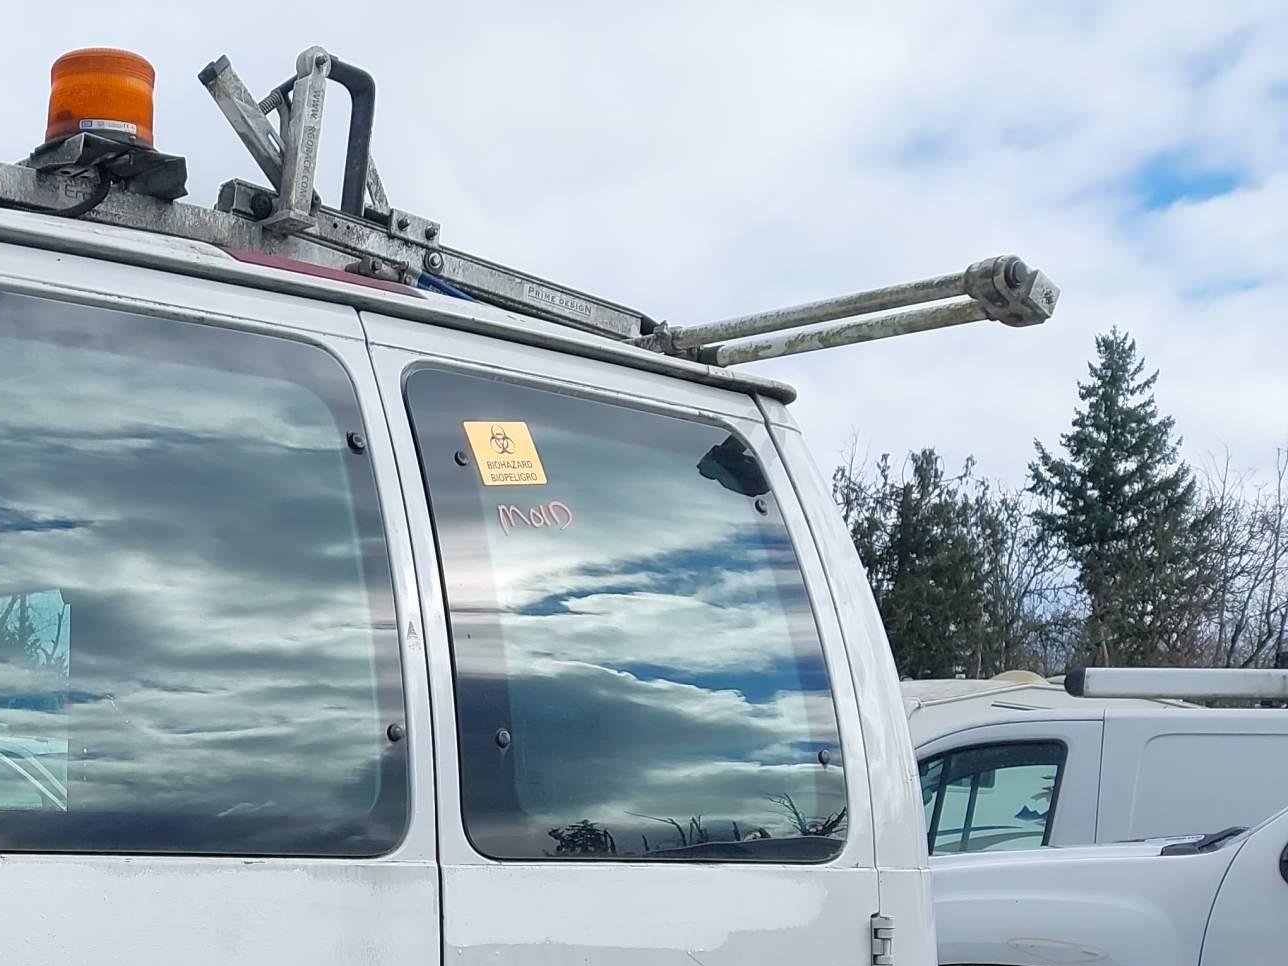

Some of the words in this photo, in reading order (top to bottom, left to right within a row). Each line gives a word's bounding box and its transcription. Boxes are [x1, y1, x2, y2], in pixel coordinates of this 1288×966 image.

[528, 286, 556, 303] PRIME
[558, 297, 592, 314] DESIGN
[486, 460, 533, 470] BIOHAZARD
[490, 472, 538, 482] BIOPELIGRO
